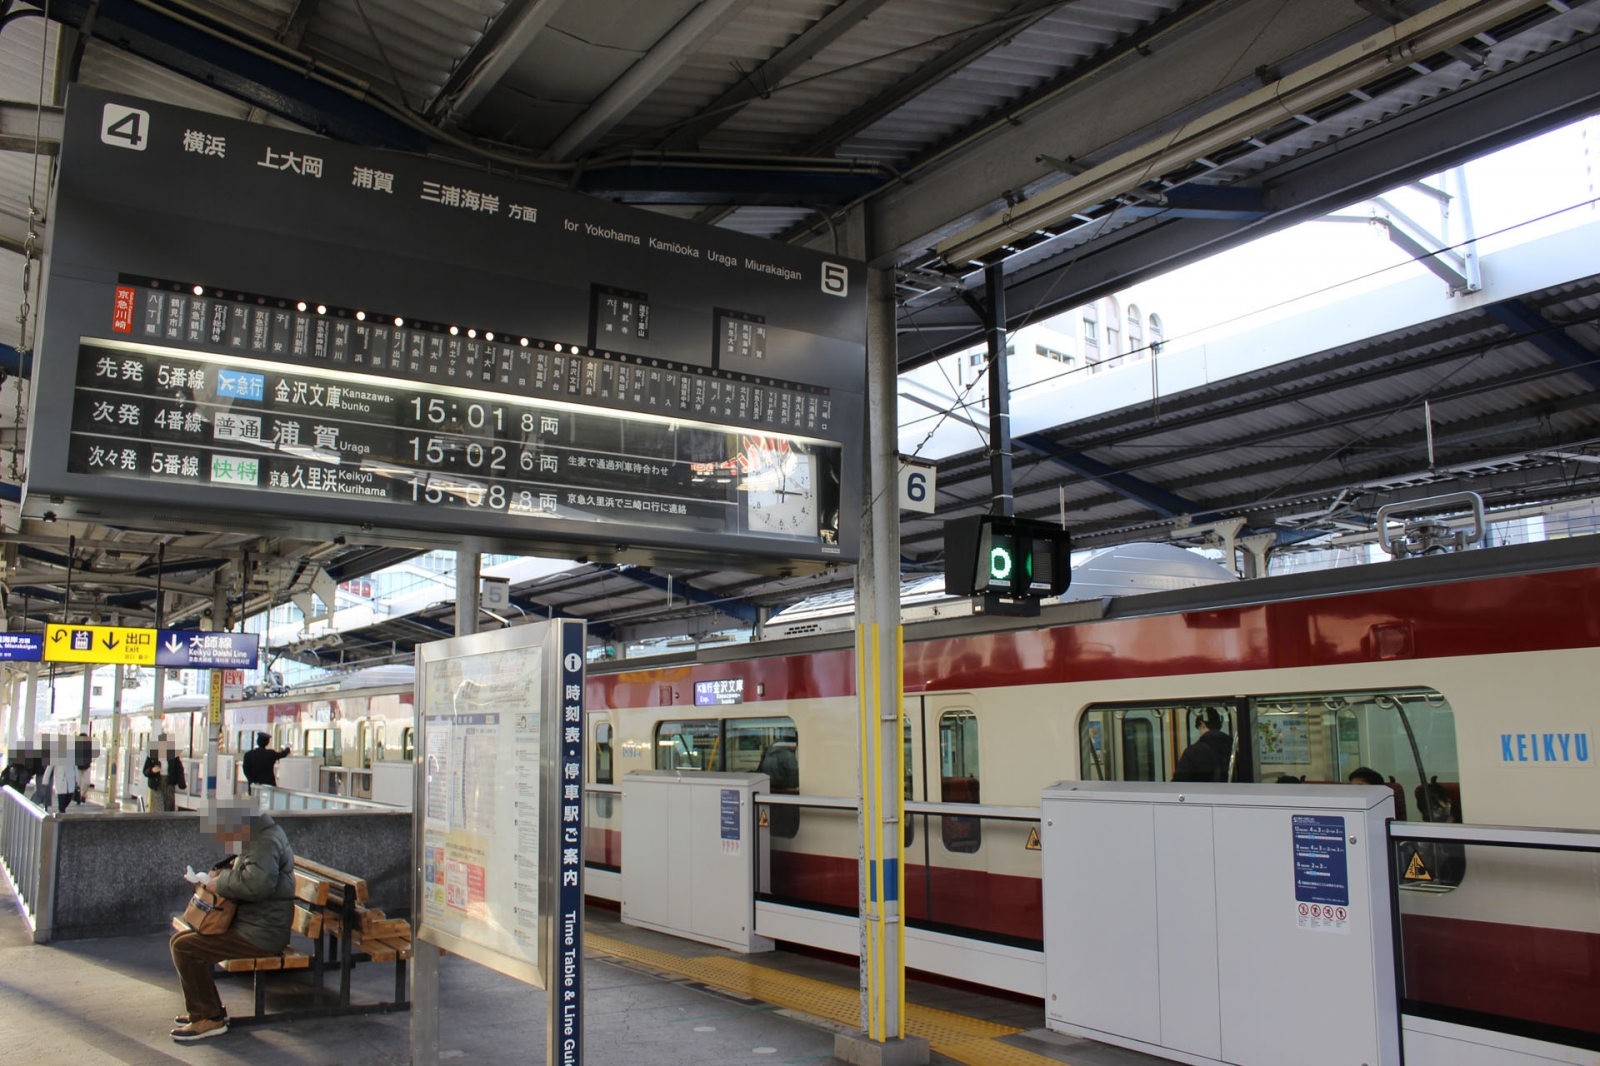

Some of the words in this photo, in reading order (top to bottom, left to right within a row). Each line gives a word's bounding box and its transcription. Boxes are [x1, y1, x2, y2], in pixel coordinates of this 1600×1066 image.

[108, 111, 142, 146] 4
[183, 129, 226, 158] 横浜
[257, 147, 322, 178] 上大岡
[352, 166, 394, 194] 浦賀
[420, 181, 500, 214] 三浦海岸
[508, 204, 538, 223] 方面
[564, 219, 578, 232] for
[584, 223, 640, 245] Yokohama
[708, 250, 737, 267] Uraga
[744, 258, 802, 282] Miurakaigan
[824, 265, 846, 293] 5
[115, 290, 130, 330] 京急川崎
[168, 298, 180, 338] 鶴見市場
[190, 302, 202, 340] 京急鶴見
[274, 314, 284, 352] 子安
[334, 324, 344, 360] 神奈川
[354, 326, 365, 363] 横浜
[392, 332, 401, 368] 日ノ出町
[430, 338, 439, 373] 南太田
[483, 346, 492, 380] 上大岡
[518, 352, 528, 386] 杉田
[96, 357, 144, 382] 先発
[158, 365, 205, 390] 5番線
[237, 379, 263, 398] 急行
[275, 379, 340, 410] 金沢文庫
[342, 388, 394, 403] Kanazawa-
[341, 401, 370, 412] bunko
[411, 396, 504, 430] 15:01
[520, 412, 560, 435] 8両
[92, 401, 140, 426] 次発
[154, 410, 202, 433] 4番線
[216, 416, 260, 440] 普通
[272, 420, 340, 451] 浦賀
[340, 442, 370, 454] Uraga
[409, 436, 506, 470] 15:02
[520, 452, 558, 474] 6両
[568, 456, 670, 476] 生麦で通過列車待合わせ
[88, 445, 138, 470] 次々発
[150, 452, 200, 477] 5番線
[212, 459, 258, 481] 快特
[270, 464, 338, 492] 京急久里浜
[339, 468, 374, 484] Keikyū
[338, 483, 386, 497] Kurihama
[407, 477, 506, 510] 15:08
[520, 491, 558, 512] 8両
[568, 492, 687, 515] 京急久里浜で三崎口行に連絡
[907, 472, 926, 502] 6
[488, 586, 502, 603] 5
[126, 632, 150, 644] 出口
[189, 648, 211, 657] Keikyū
[212, 649, 232, 657] Daishi
[234, 650, 247, 658] Line
[190, 635, 232, 649] 大師線
[170, 670, 178, 679] 3
[714, 679, 744, 694] 金沢文庫
[1500, 733, 1588, 762] KEIKYU
[564, 684, 580, 886] 時刻表・停車駅ご案内
[564, 910, 576, 946] Time
[564, 948, 576, 986] Table
[564, 990, 575, 1001] &
[564, 1004, 575, 1036] Line
[564, 1038, 575, 1066] Gui
